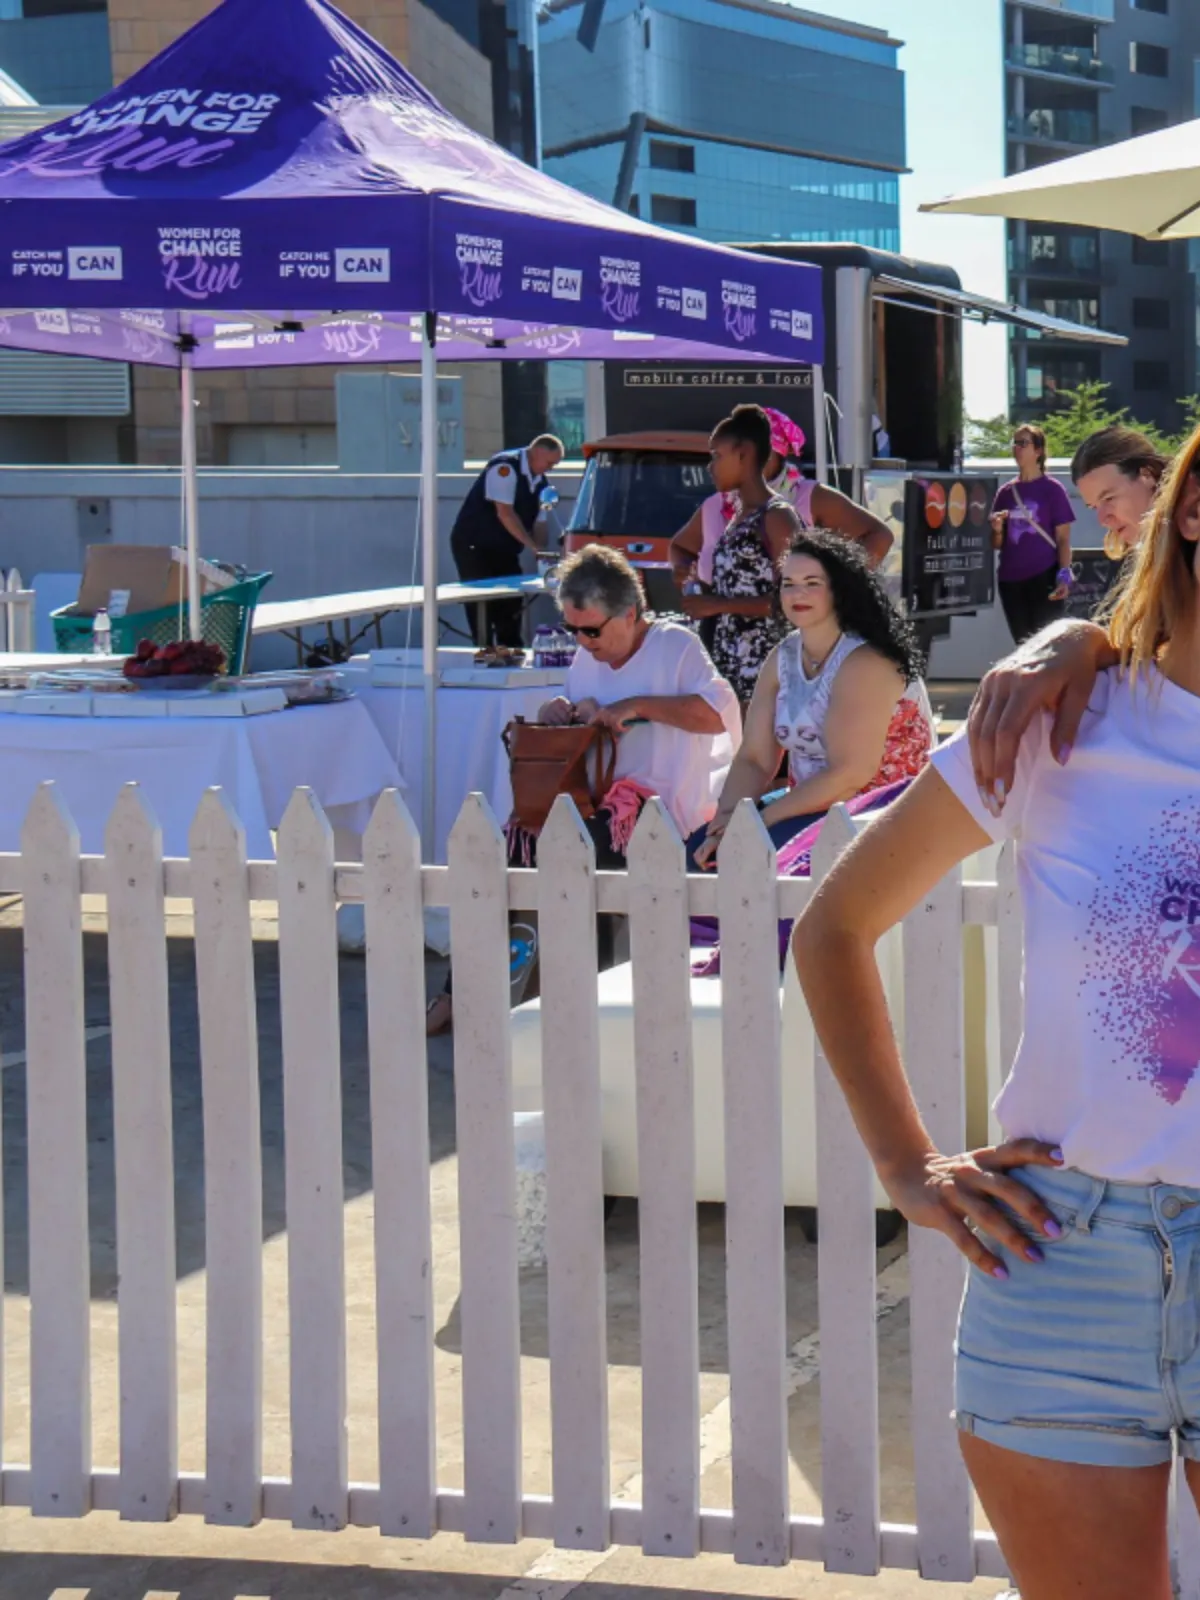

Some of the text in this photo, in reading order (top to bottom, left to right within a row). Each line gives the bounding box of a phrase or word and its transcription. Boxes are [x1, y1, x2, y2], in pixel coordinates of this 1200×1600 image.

[203, 92, 281, 112] FOR
[158, 228, 241, 239] WOMEN FOR
[159, 240, 242, 257] CHANGE
[456, 245, 503, 267] CHANGE
[12, 263, 63, 276] IF YOU
[77, 256, 115, 271] CAN
[280, 264, 330, 277] IF YOU
[343, 257, 382, 273] CAN
[162, 255, 242, 300] Run
[458, 261, 503, 307] Run
[556, 276, 578, 292] CAN
[600, 267, 641, 287] CHANGE
[522, 278, 550, 293] IF YOU
[601, 281, 640, 323] Run
[686, 295, 703, 310] CAN
[629, 372, 811, 385] mobile coffee & food
